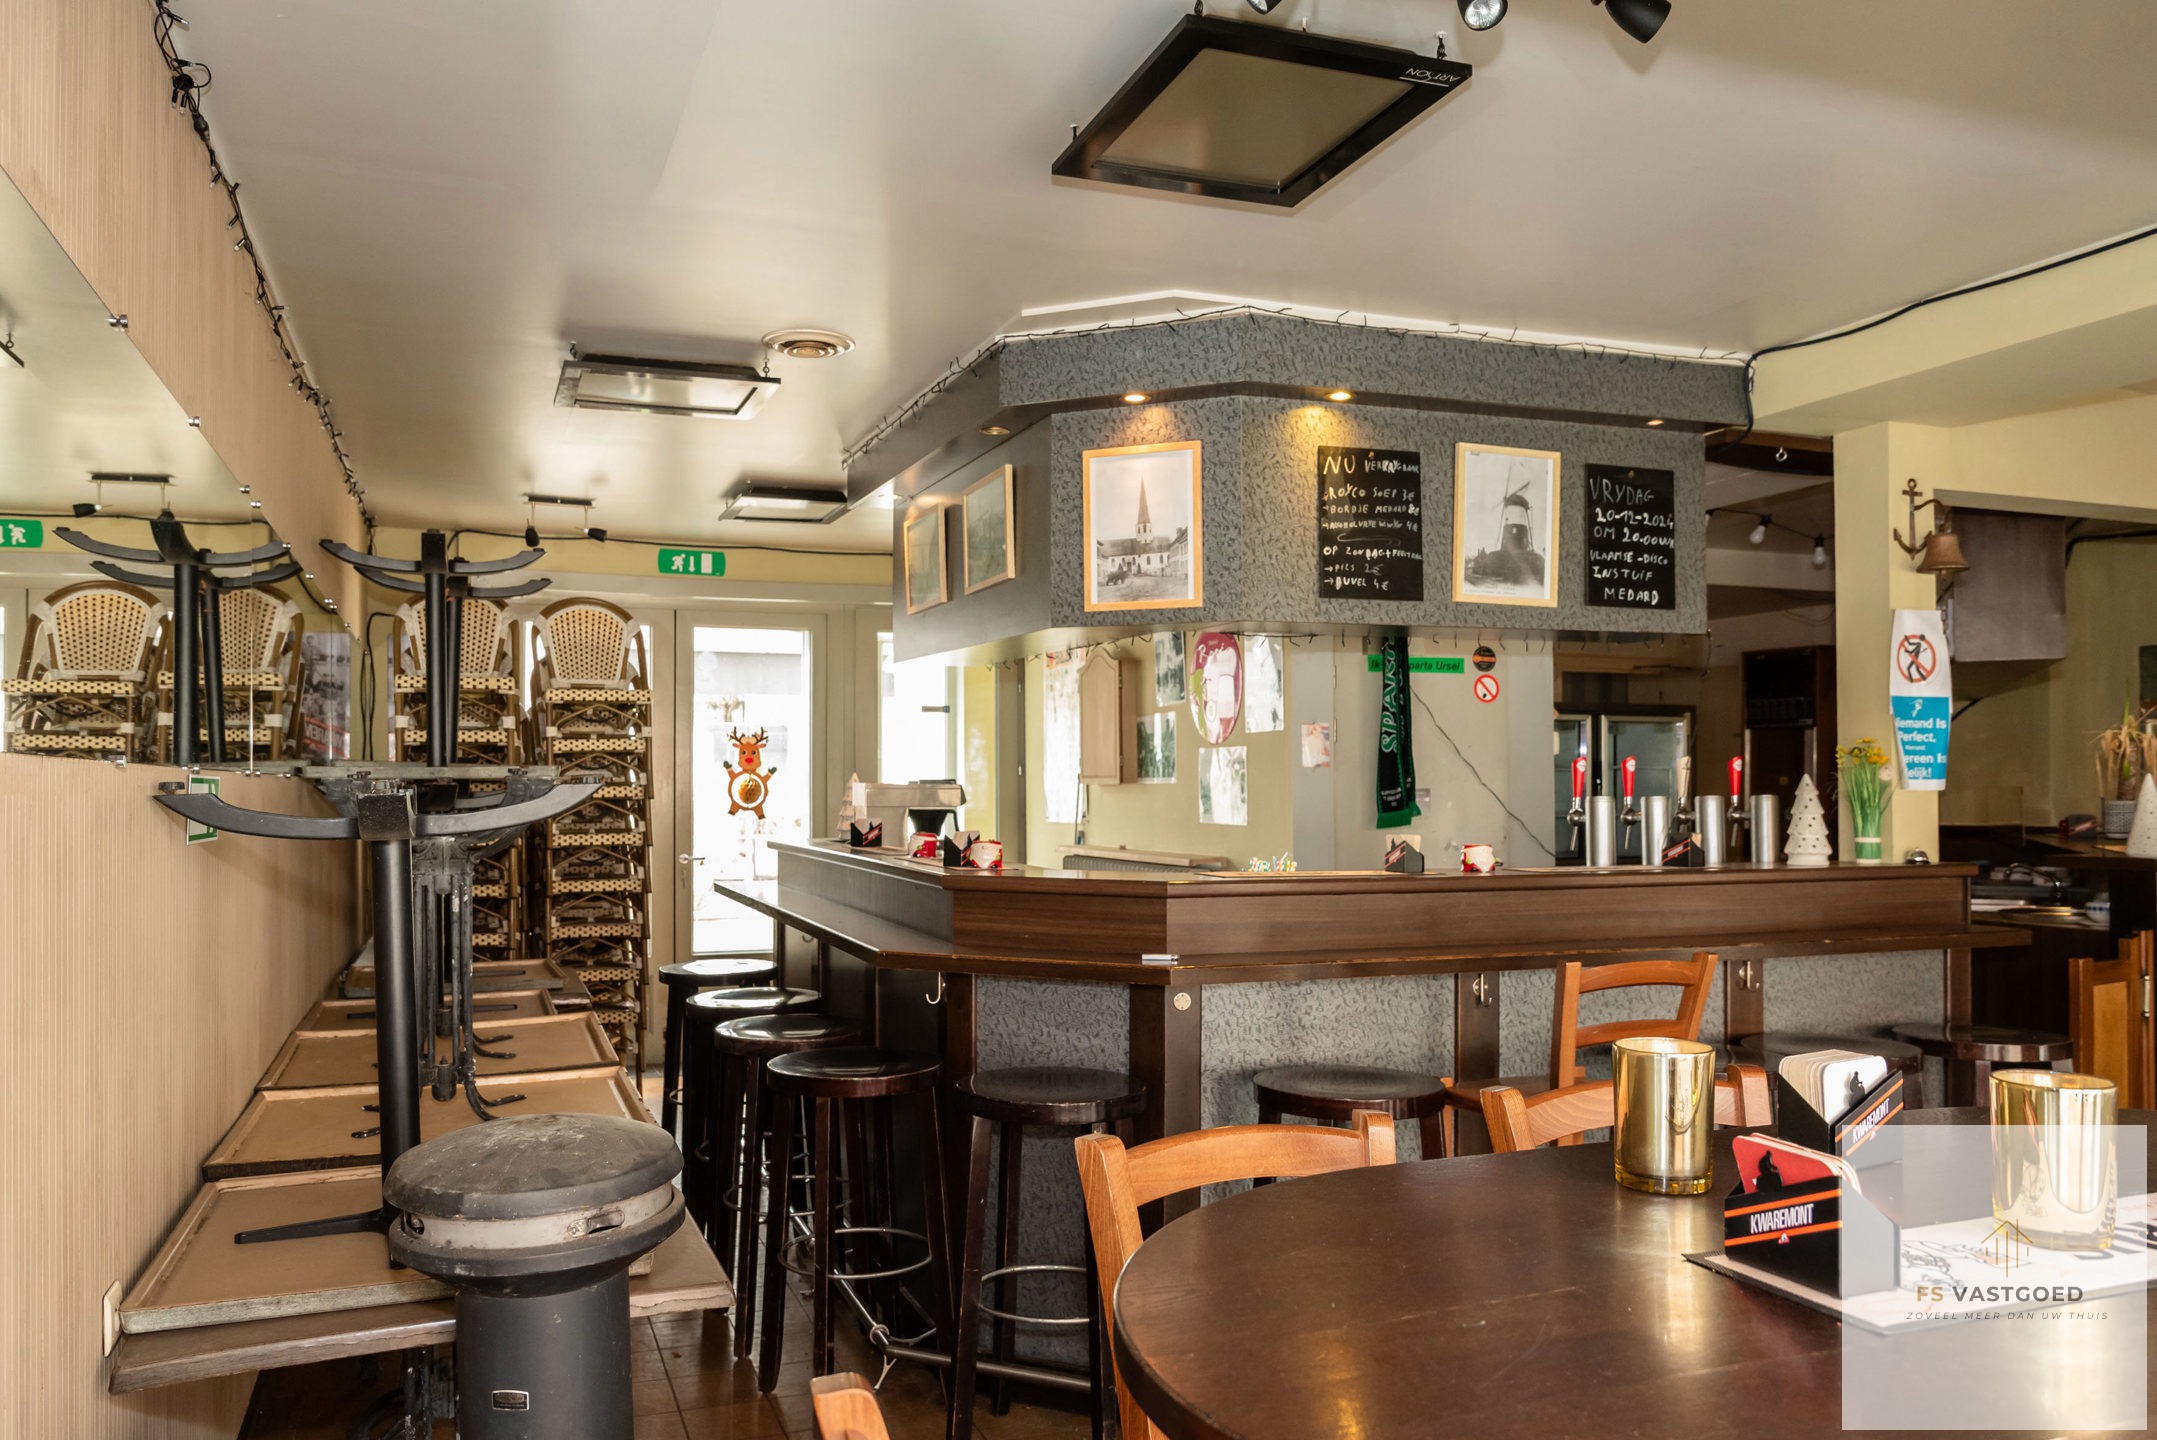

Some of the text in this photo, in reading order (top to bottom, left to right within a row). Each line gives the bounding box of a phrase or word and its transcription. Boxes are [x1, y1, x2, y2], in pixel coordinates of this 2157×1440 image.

[1323, 455, 1356, 474] NU
[1328, 483, 1367, 500] ROYCO
[1590, 476, 1655, 506] VRYDAG
[1595, 507, 1674, 530] 20-12-2024
[1593, 526, 1615, 540] OM
[1323, 545, 1338, 555] OP
[1590, 549, 1634, 563] VLAAMSE
[1335, 576, 1367, 591] DUVEL
[1604, 587, 1659, 605] MEDARD
[1409, 661, 1432, 671] parta
[1852, 1097, 1891, 1144] KWAREMONT
[1750, 1203, 1815, 1235] KWAREMONT
